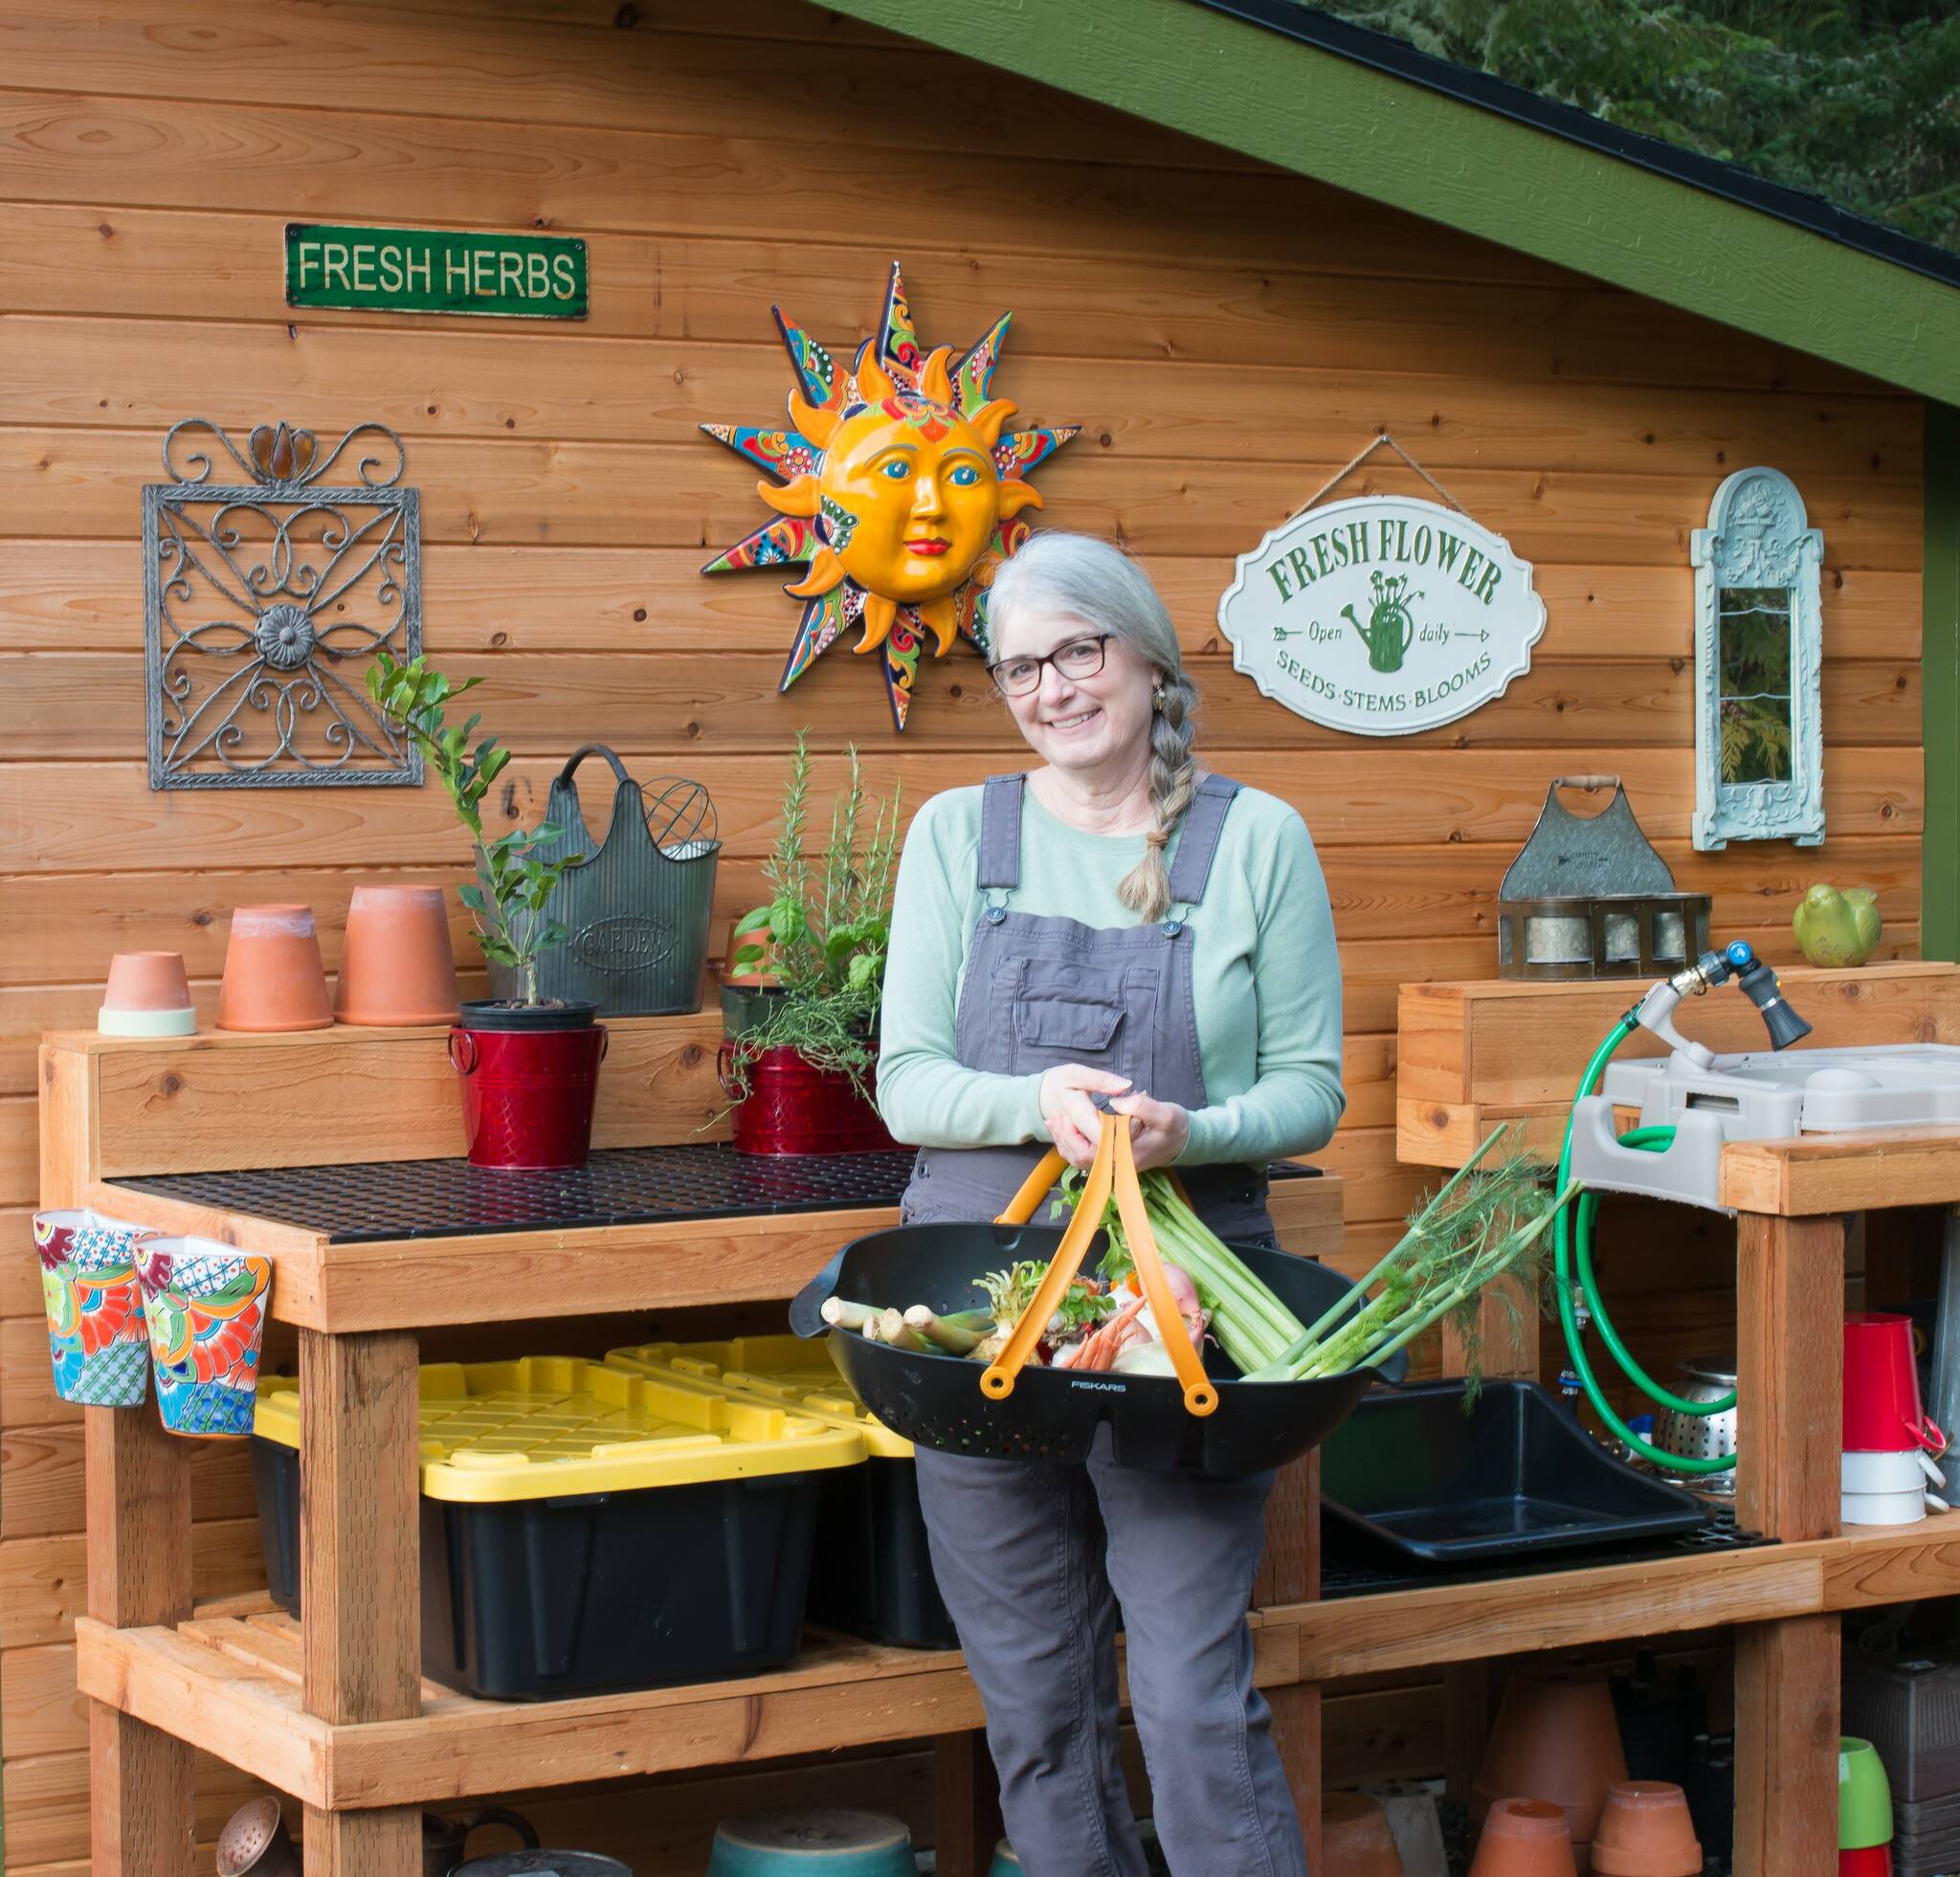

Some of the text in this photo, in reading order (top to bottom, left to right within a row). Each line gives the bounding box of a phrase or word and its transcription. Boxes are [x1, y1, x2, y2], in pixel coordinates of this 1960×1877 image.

[299, 242, 576, 300] FRESH HERBS
[1265, 520, 1503, 605] FRESH FLOWER
[1308, 620, 1450, 644] Open daily
[1276, 650, 1492, 712] SEEDS STEMS BLOOMS
[581, 927, 666, 955] GARDEN
[1071, 1379, 1126, 1393] FISKARS
